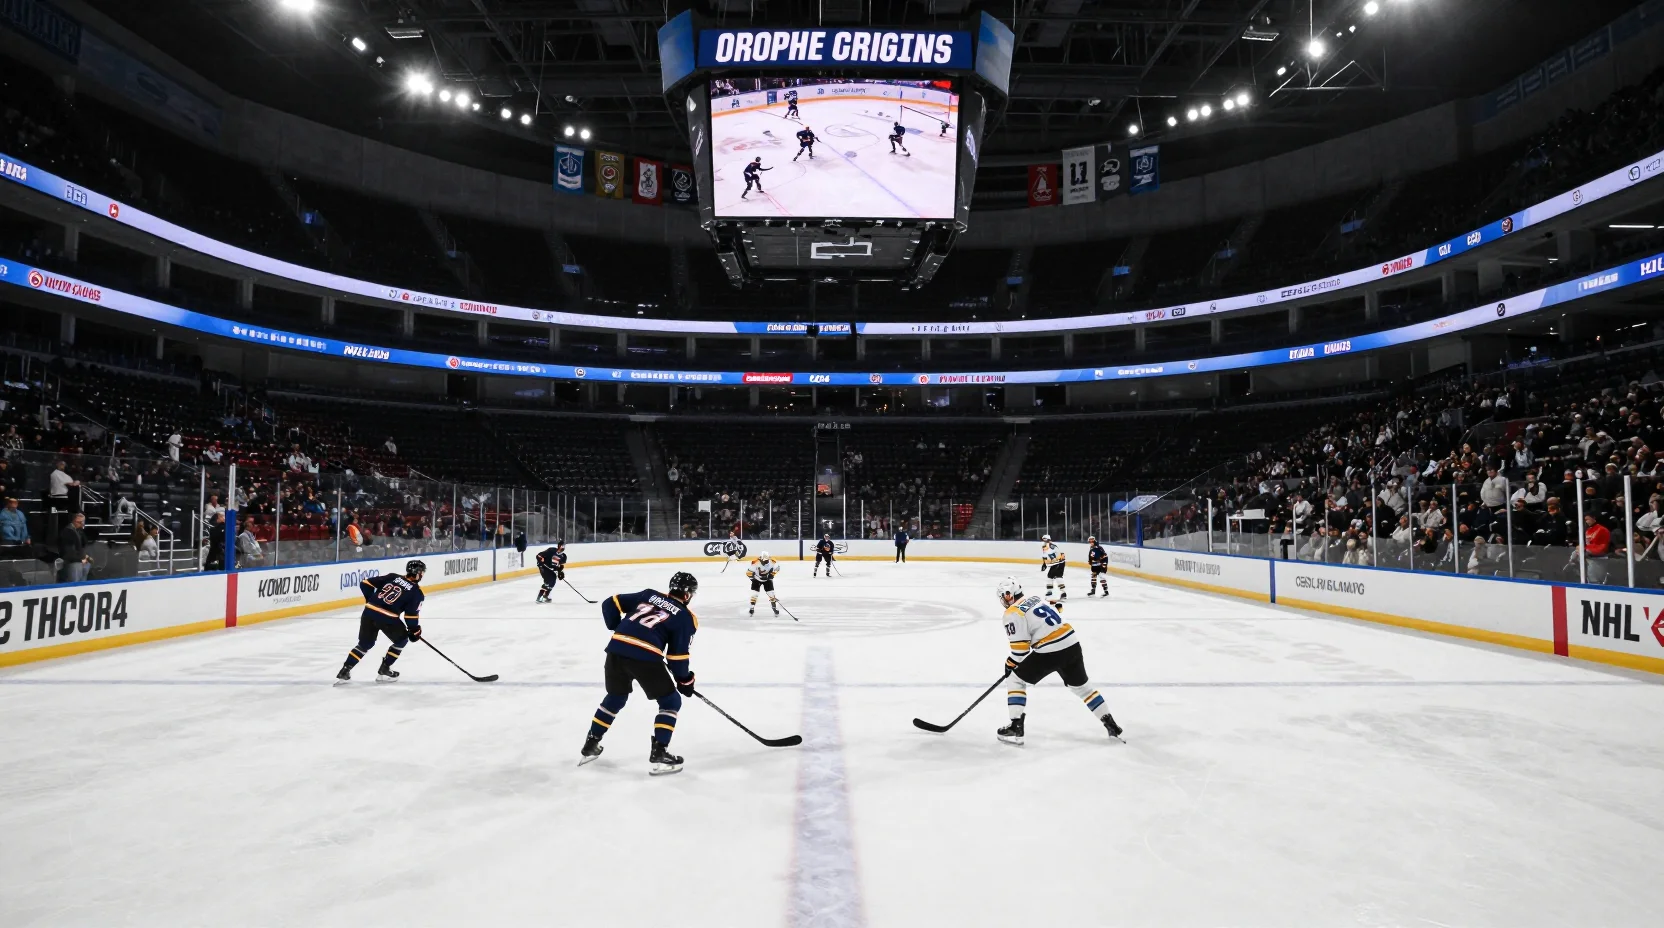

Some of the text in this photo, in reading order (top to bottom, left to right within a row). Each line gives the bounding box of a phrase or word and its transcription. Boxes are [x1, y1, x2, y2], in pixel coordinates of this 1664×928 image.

[715, 31, 826, 63] OROPHE
[23, 589, 128, 642] THCOR4
[1581, 600, 1640, 642] NHL
